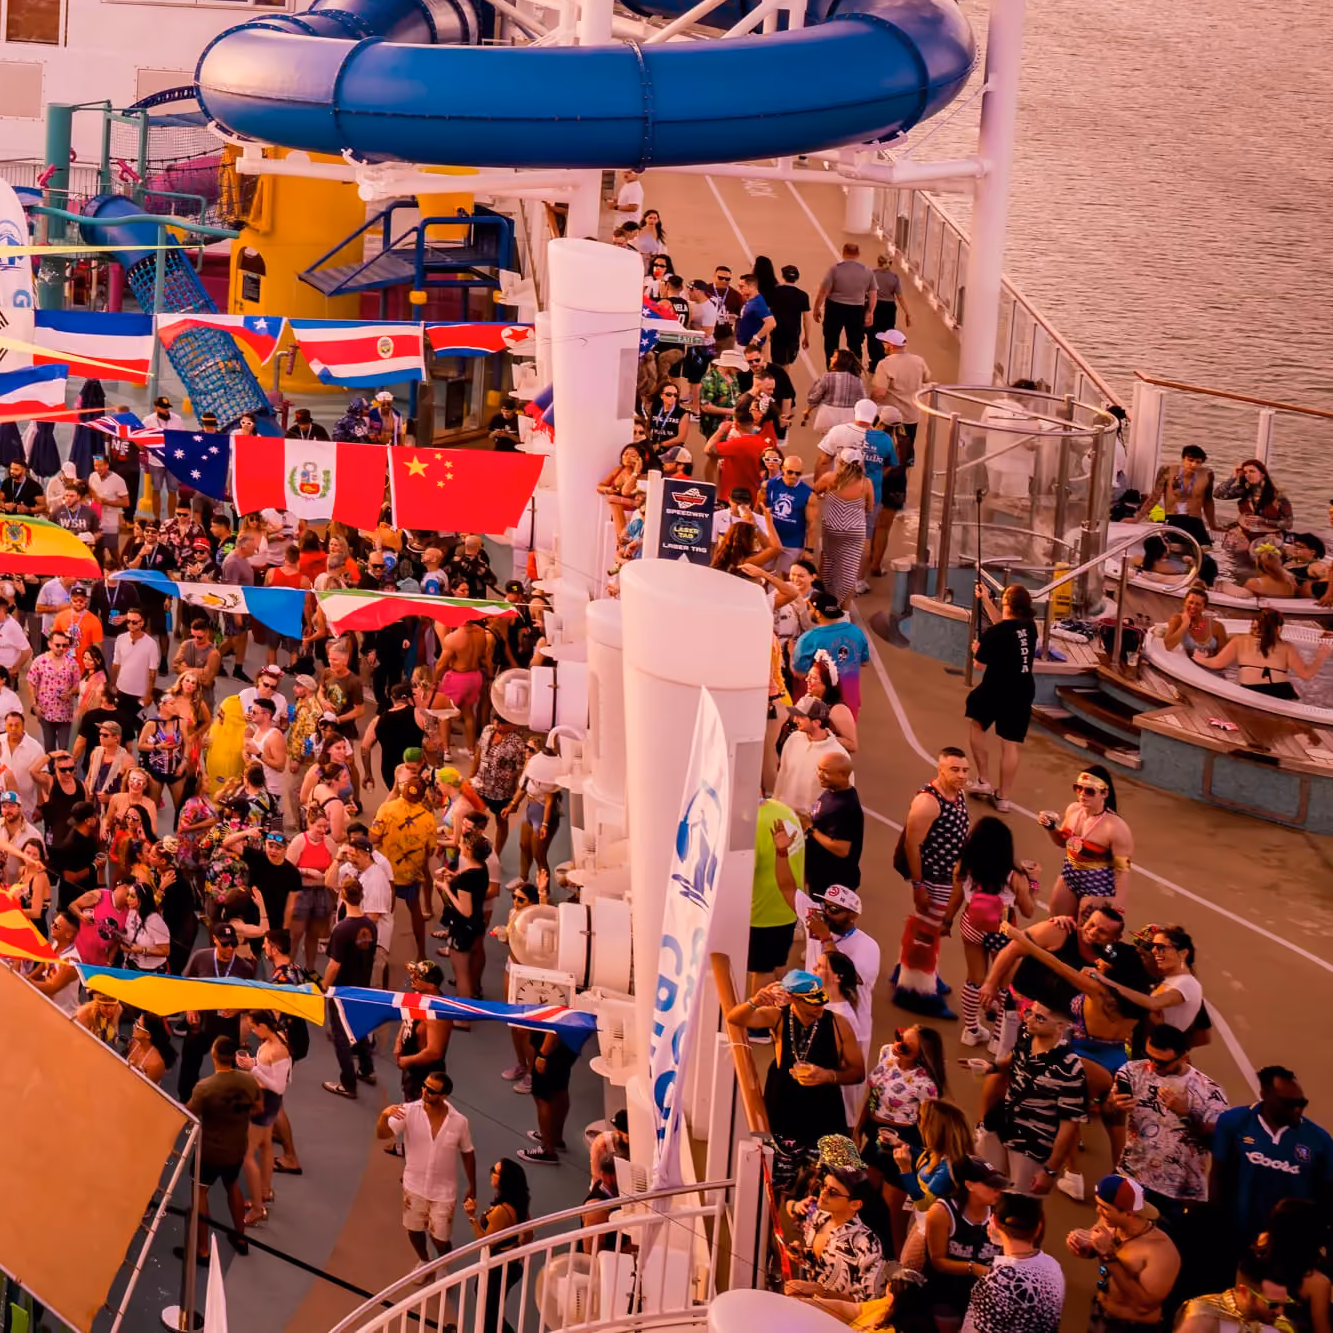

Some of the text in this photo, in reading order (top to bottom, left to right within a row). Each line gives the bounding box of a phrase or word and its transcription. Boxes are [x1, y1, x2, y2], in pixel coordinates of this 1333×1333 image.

[666, 508, 710, 518] SPEEDWAY
[59, 517, 87, 528] WSH
[662, 543, 689, 551] LASER
[1016, 628, 1030, 674] MEDIA
[1245, 1152, 1300, 1174] Coors
